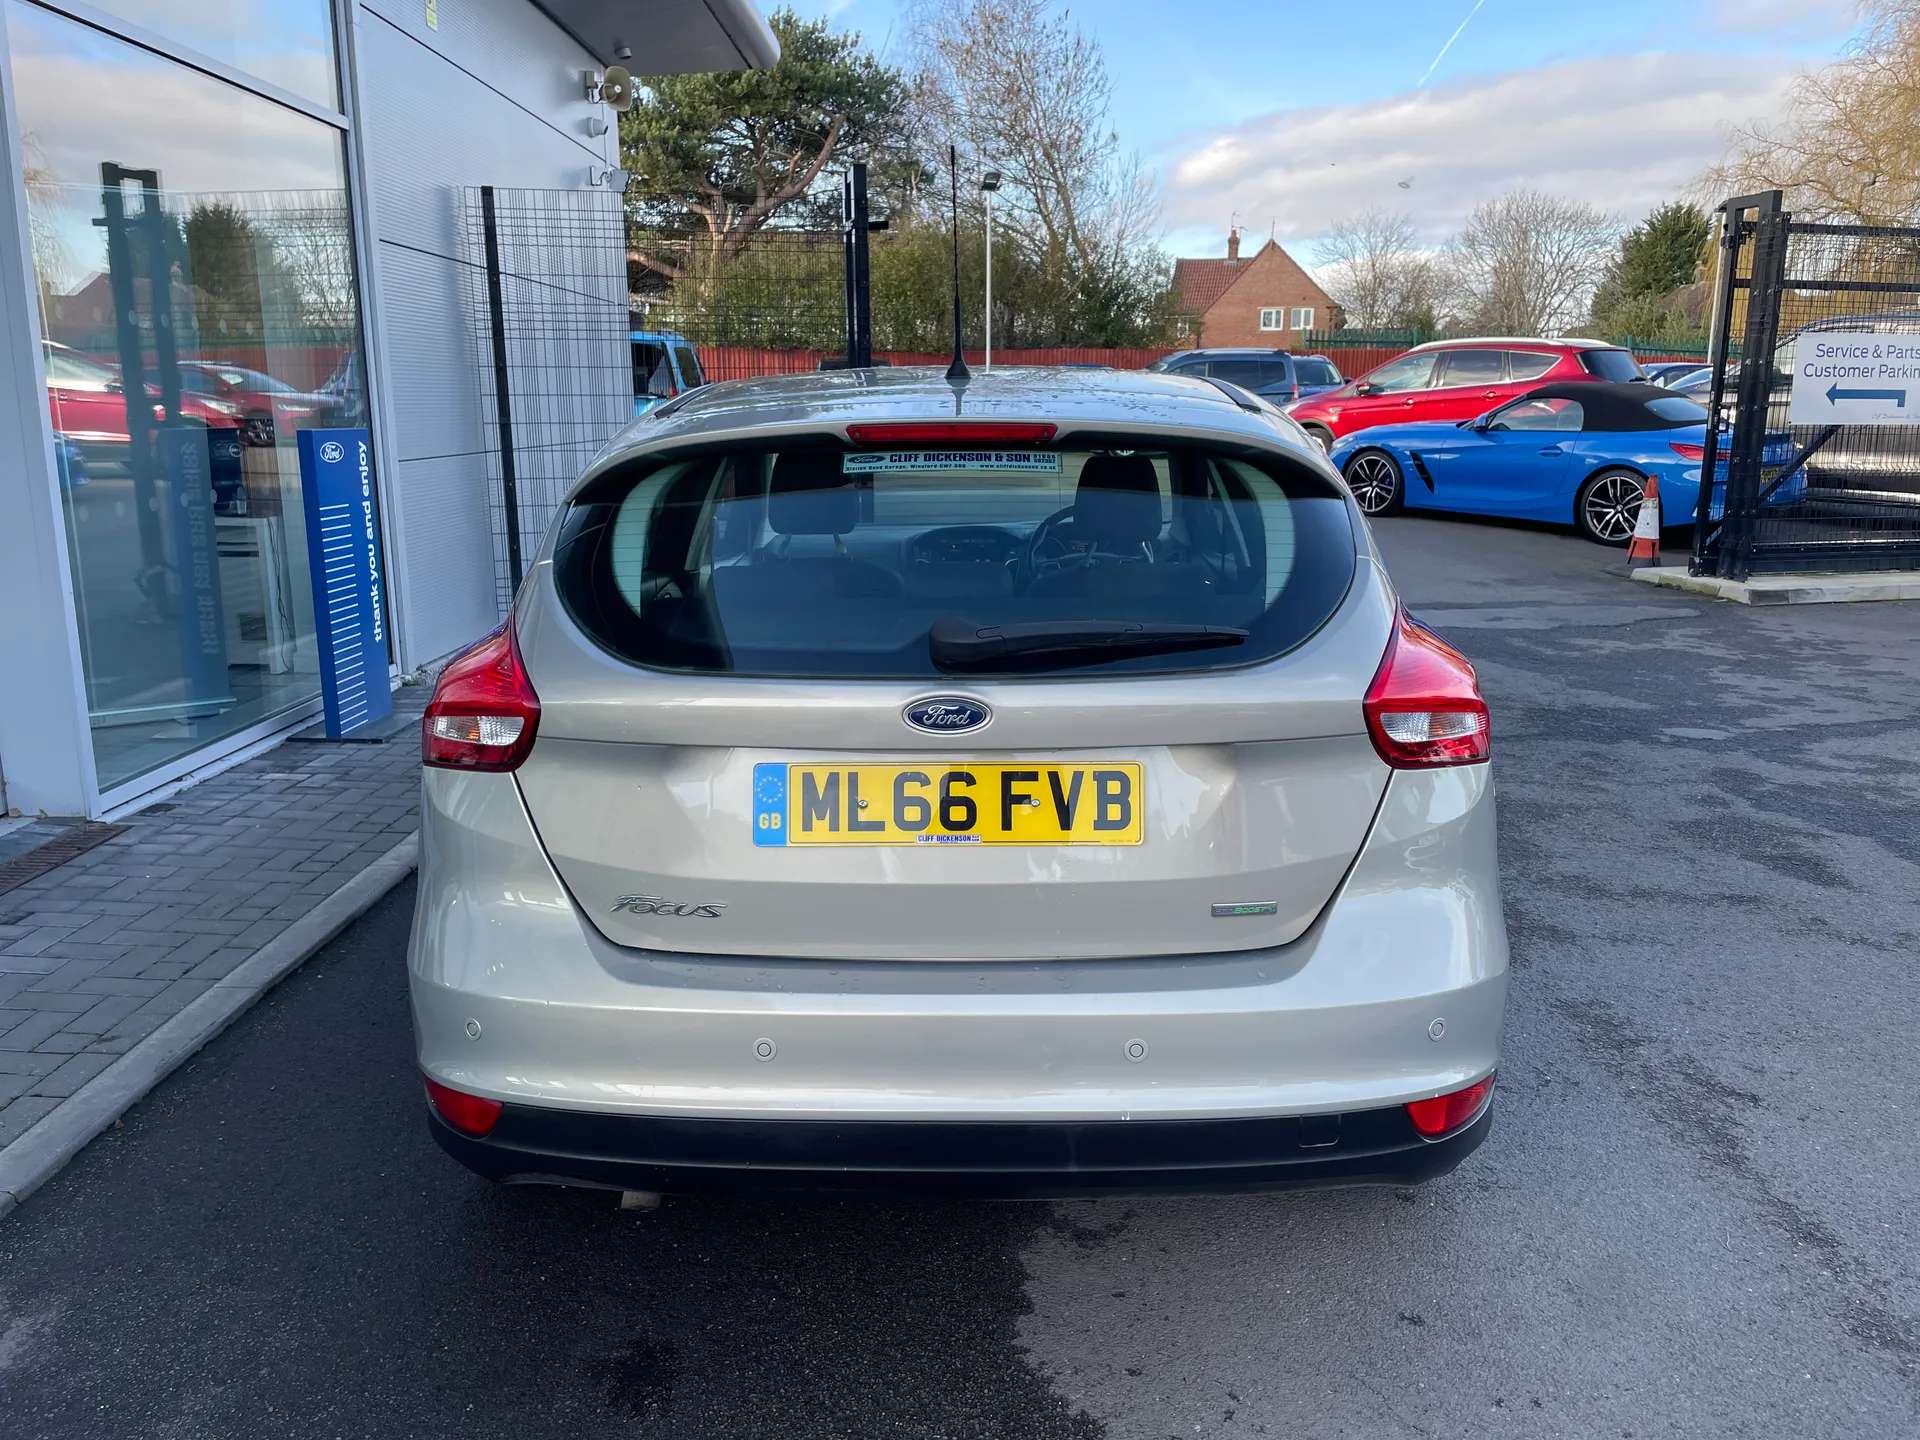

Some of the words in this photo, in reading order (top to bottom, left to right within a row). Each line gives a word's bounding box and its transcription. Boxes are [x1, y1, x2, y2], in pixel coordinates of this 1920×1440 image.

[1815, 343, 1869, 359] Service
[1871, 344, 1883, 359] &
[1886, 344, 1920, 360] Parts
[1803, 362, 1876, 378] Customer
[1878, 363, 1920, 379] Parkin
[357, 440, 370, 497] enjoy
[889, 453, 921, 463] CLIFF
[923, 452, 992, 462] DICKENSON
[994, 453, 1003, 462] &
[1006, 453, 1031, 463] SON
[361, 500, 374, 540] and
[367, 543, 379, 582] you
[370, 583, 383, 643] thank
[922, 703, 971, 727] Ford
[800, 770, 978, 833] ML66
[1000, 770, 1133, 832] FVB
[757, 811, 782, 831] GB
[917, 834, 934, 842] CLIFF
[936, 834, 972, 842] DICKENSON
